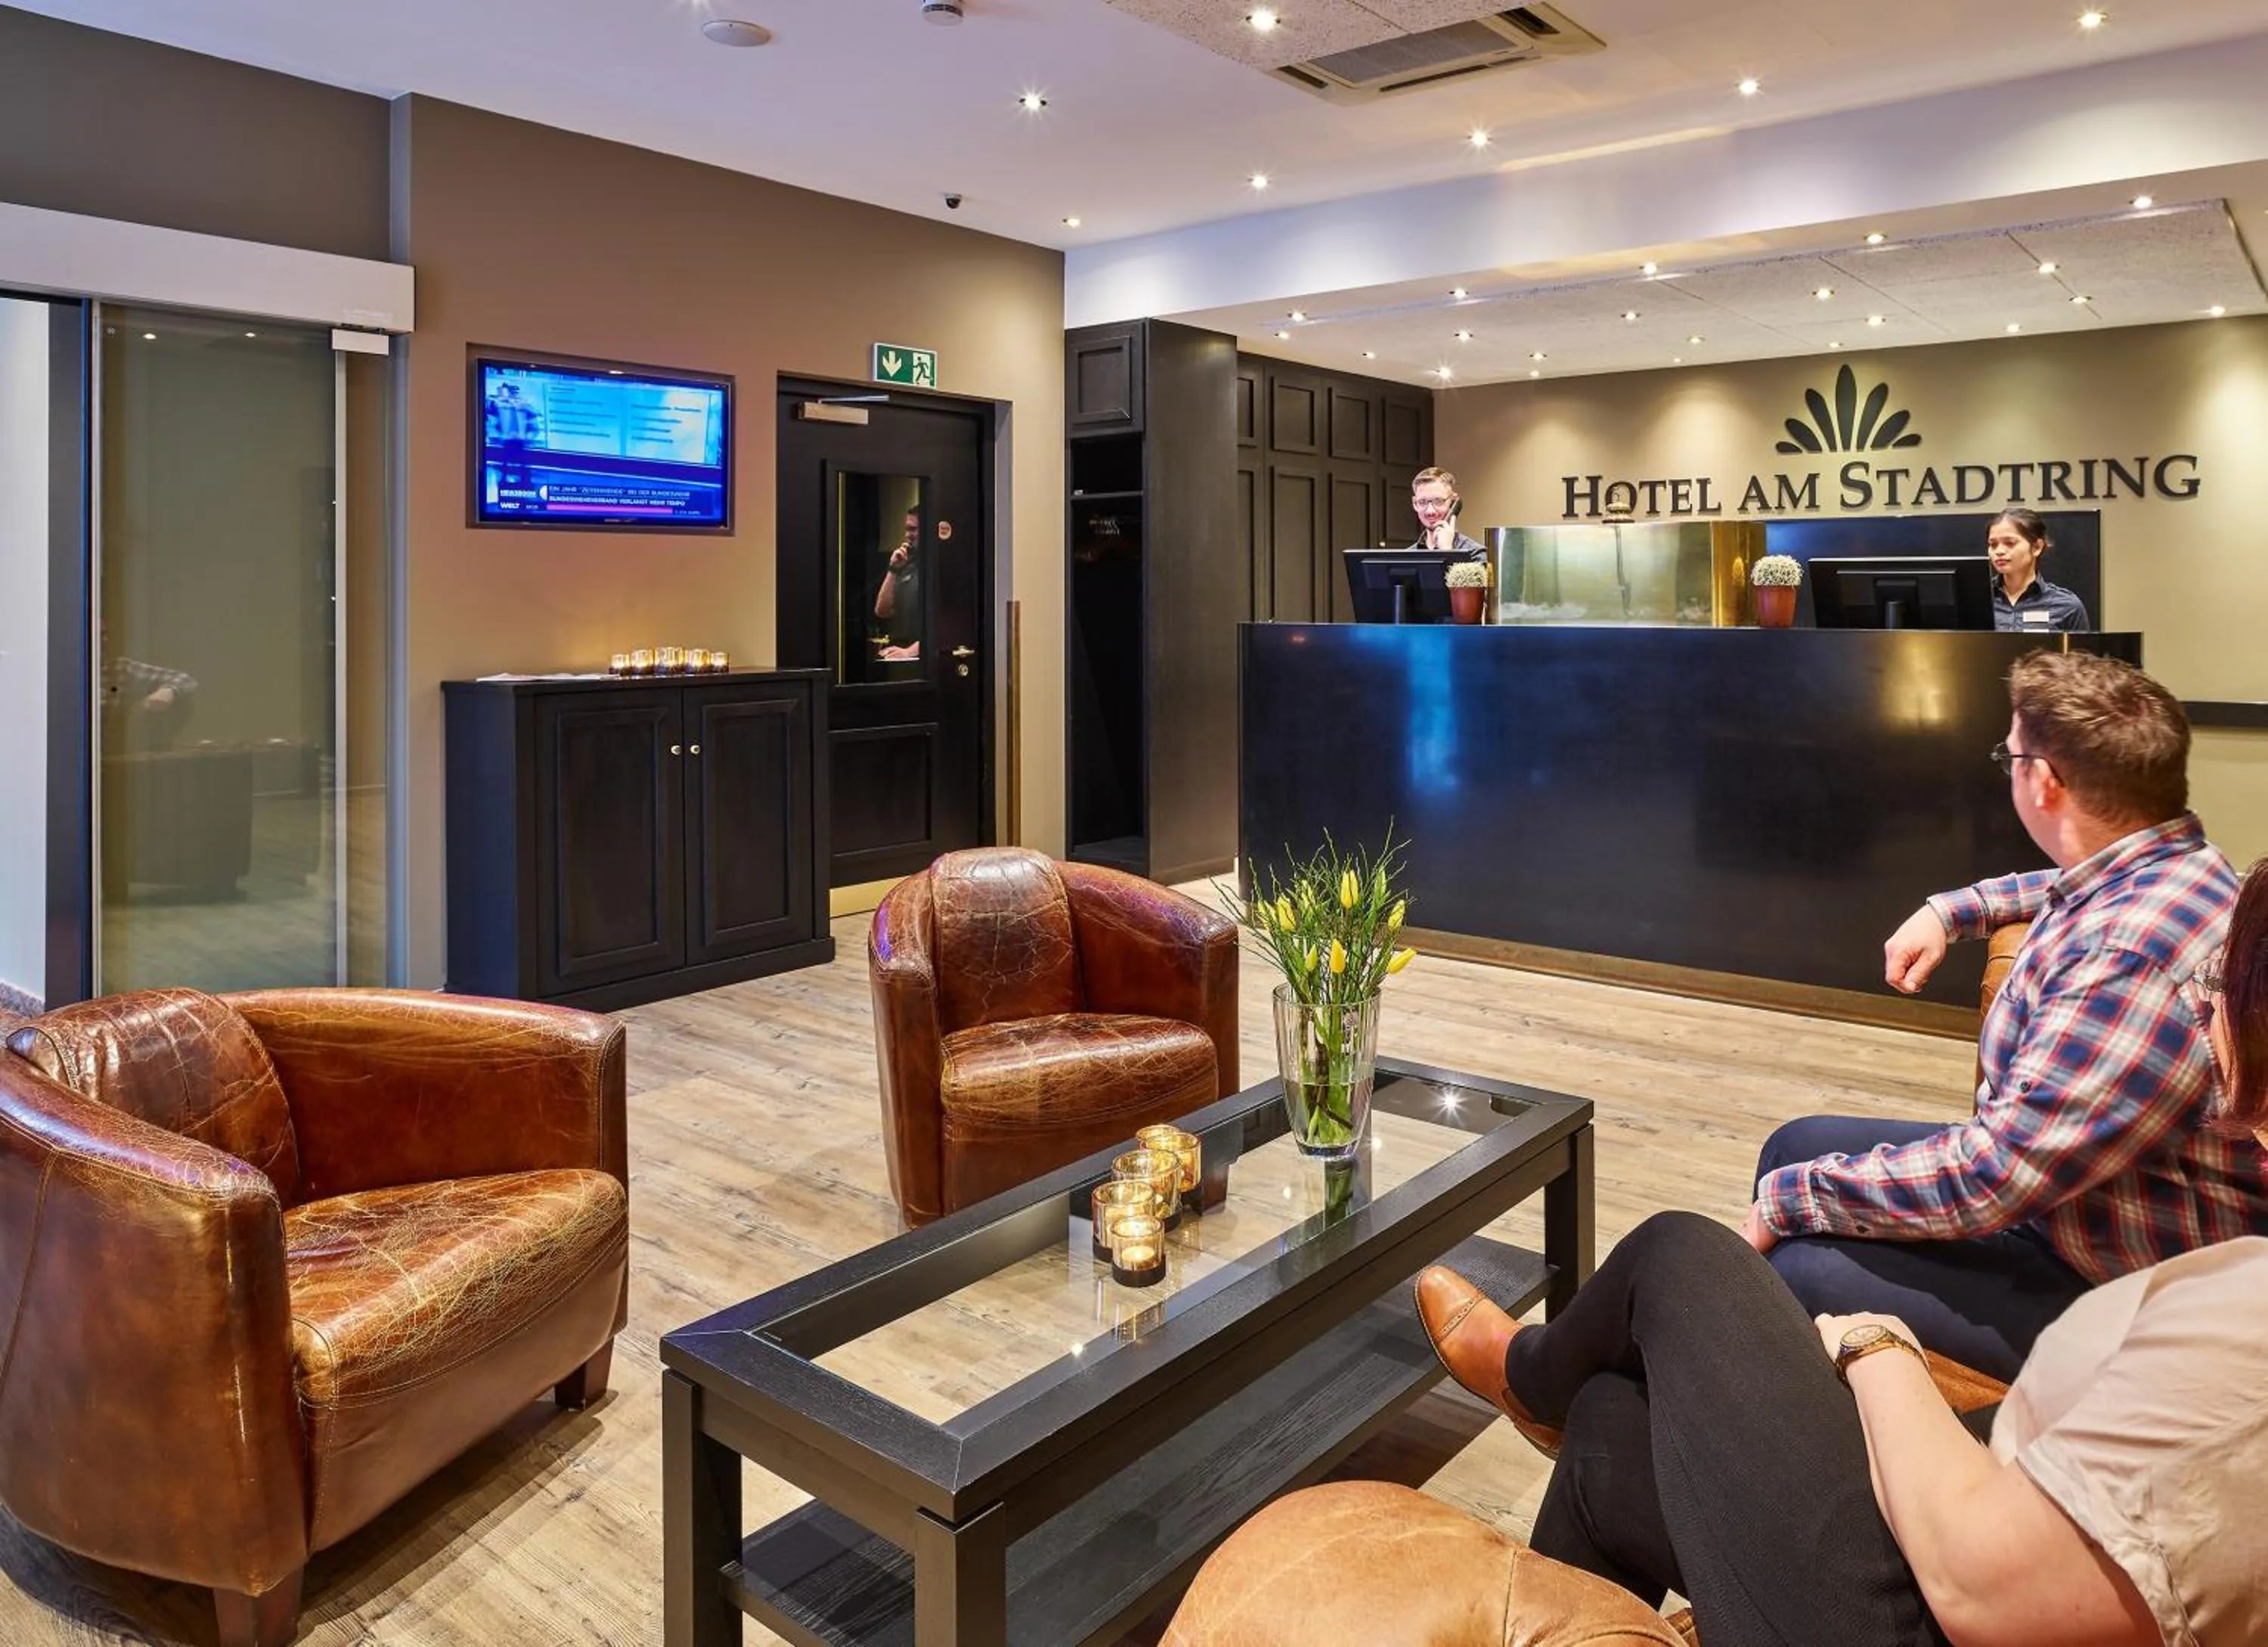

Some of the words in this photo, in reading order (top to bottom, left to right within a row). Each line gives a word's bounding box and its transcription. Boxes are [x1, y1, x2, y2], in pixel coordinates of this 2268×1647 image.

[1562, 475, 1721, 518] HOTEL
[1738, 473, 1820, 510] AM
[1840, 454, 2201, 508] STADTRING
